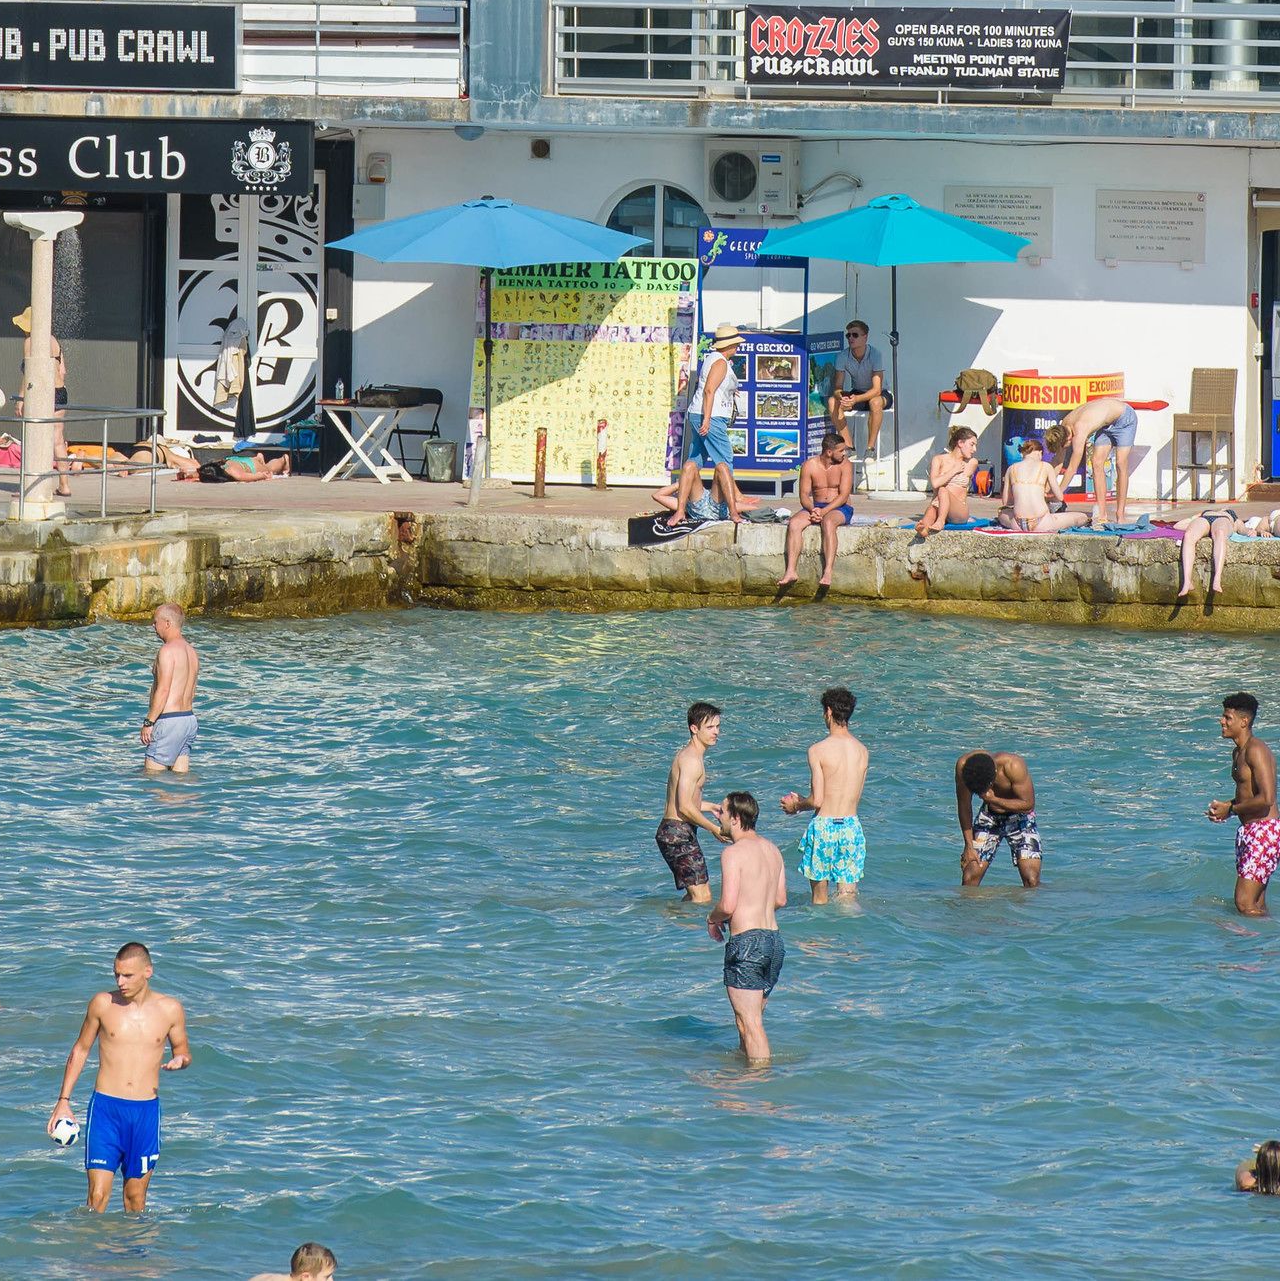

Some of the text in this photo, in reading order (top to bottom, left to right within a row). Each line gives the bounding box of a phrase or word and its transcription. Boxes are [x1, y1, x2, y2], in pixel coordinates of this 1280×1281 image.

[895, 24, 1055, 37] OPEN BAR FOR 100 MINUTES
[49, 28, 106, 62] PUB
[117, 29, 215, 64] CRAWL
[887, 37, 915, 47] GUYS
[917, 37, 934, 47] 150
[936, 37, 964, 48] KUNA
[977, 38, 1013, 48] LADIES
[1015, 38, 1032, 48] 120
[1034, 38, 1063, 49] KUNA
[750, 54, 880, 78] PUB CRAWL
[913, 53, 1035, 67] MEETING POINT 9PM
[954, 66, 1013, 78] TUDJMAN
[1018, 67, 1060, 79] STATUE
[68, 134, 187, 182] Club
[600, 260, 697, 281] TATTOO
[497, 278, 542, 288] HENNA
[547, 280, 599, 289] TATTOO
[604, 281, 617, 289] 10
[646, 282, 679, 291] DAYS
[756, 344, 794, 353] GECKO!
[1003, 383, 1081, 404] EXCURSION
[1034, 417, 1059, 430] Blue
